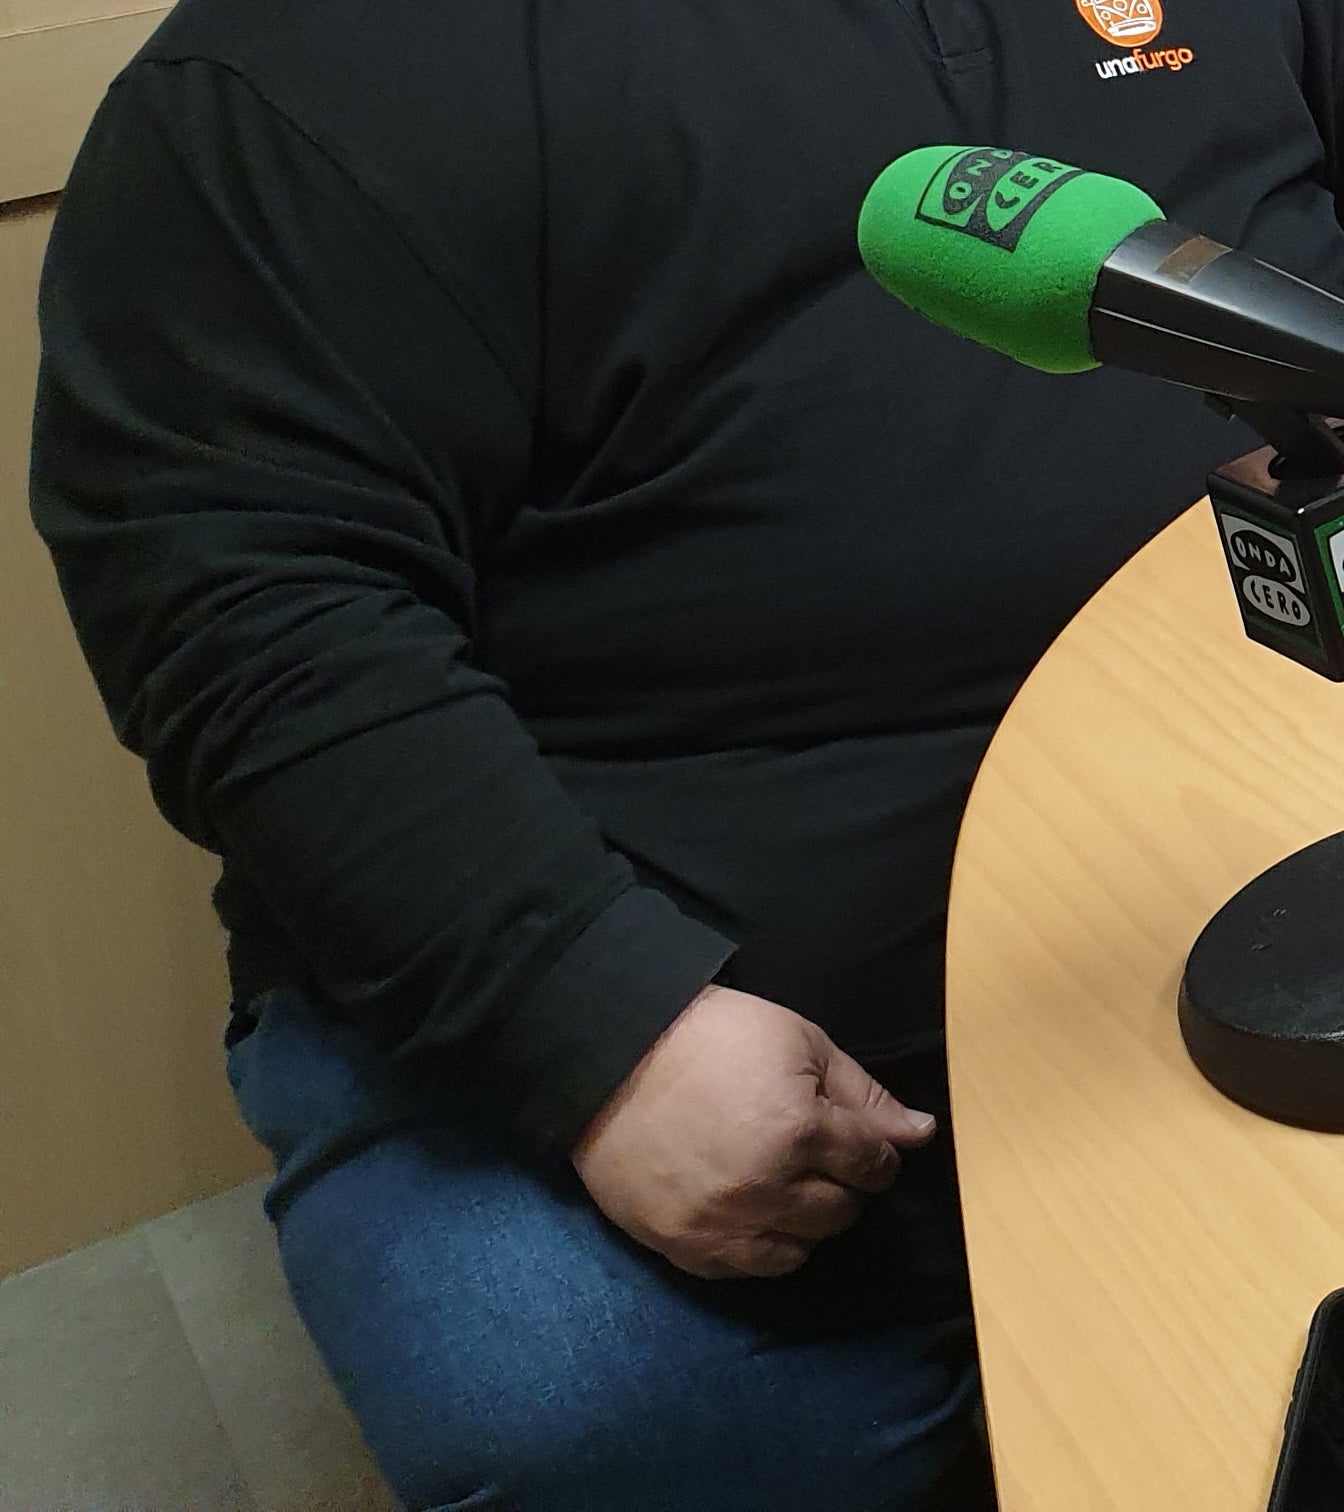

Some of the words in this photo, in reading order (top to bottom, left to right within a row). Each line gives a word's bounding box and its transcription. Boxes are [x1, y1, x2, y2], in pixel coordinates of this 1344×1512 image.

[1095, 47, 1194, 79] unafurgo
[948, 149, 1014, 200] OND
[994, 160, 1063, 209] CER
[1234, 537, 1292, 578] ONDA
[1251, 579, 1301, 618] CERO
